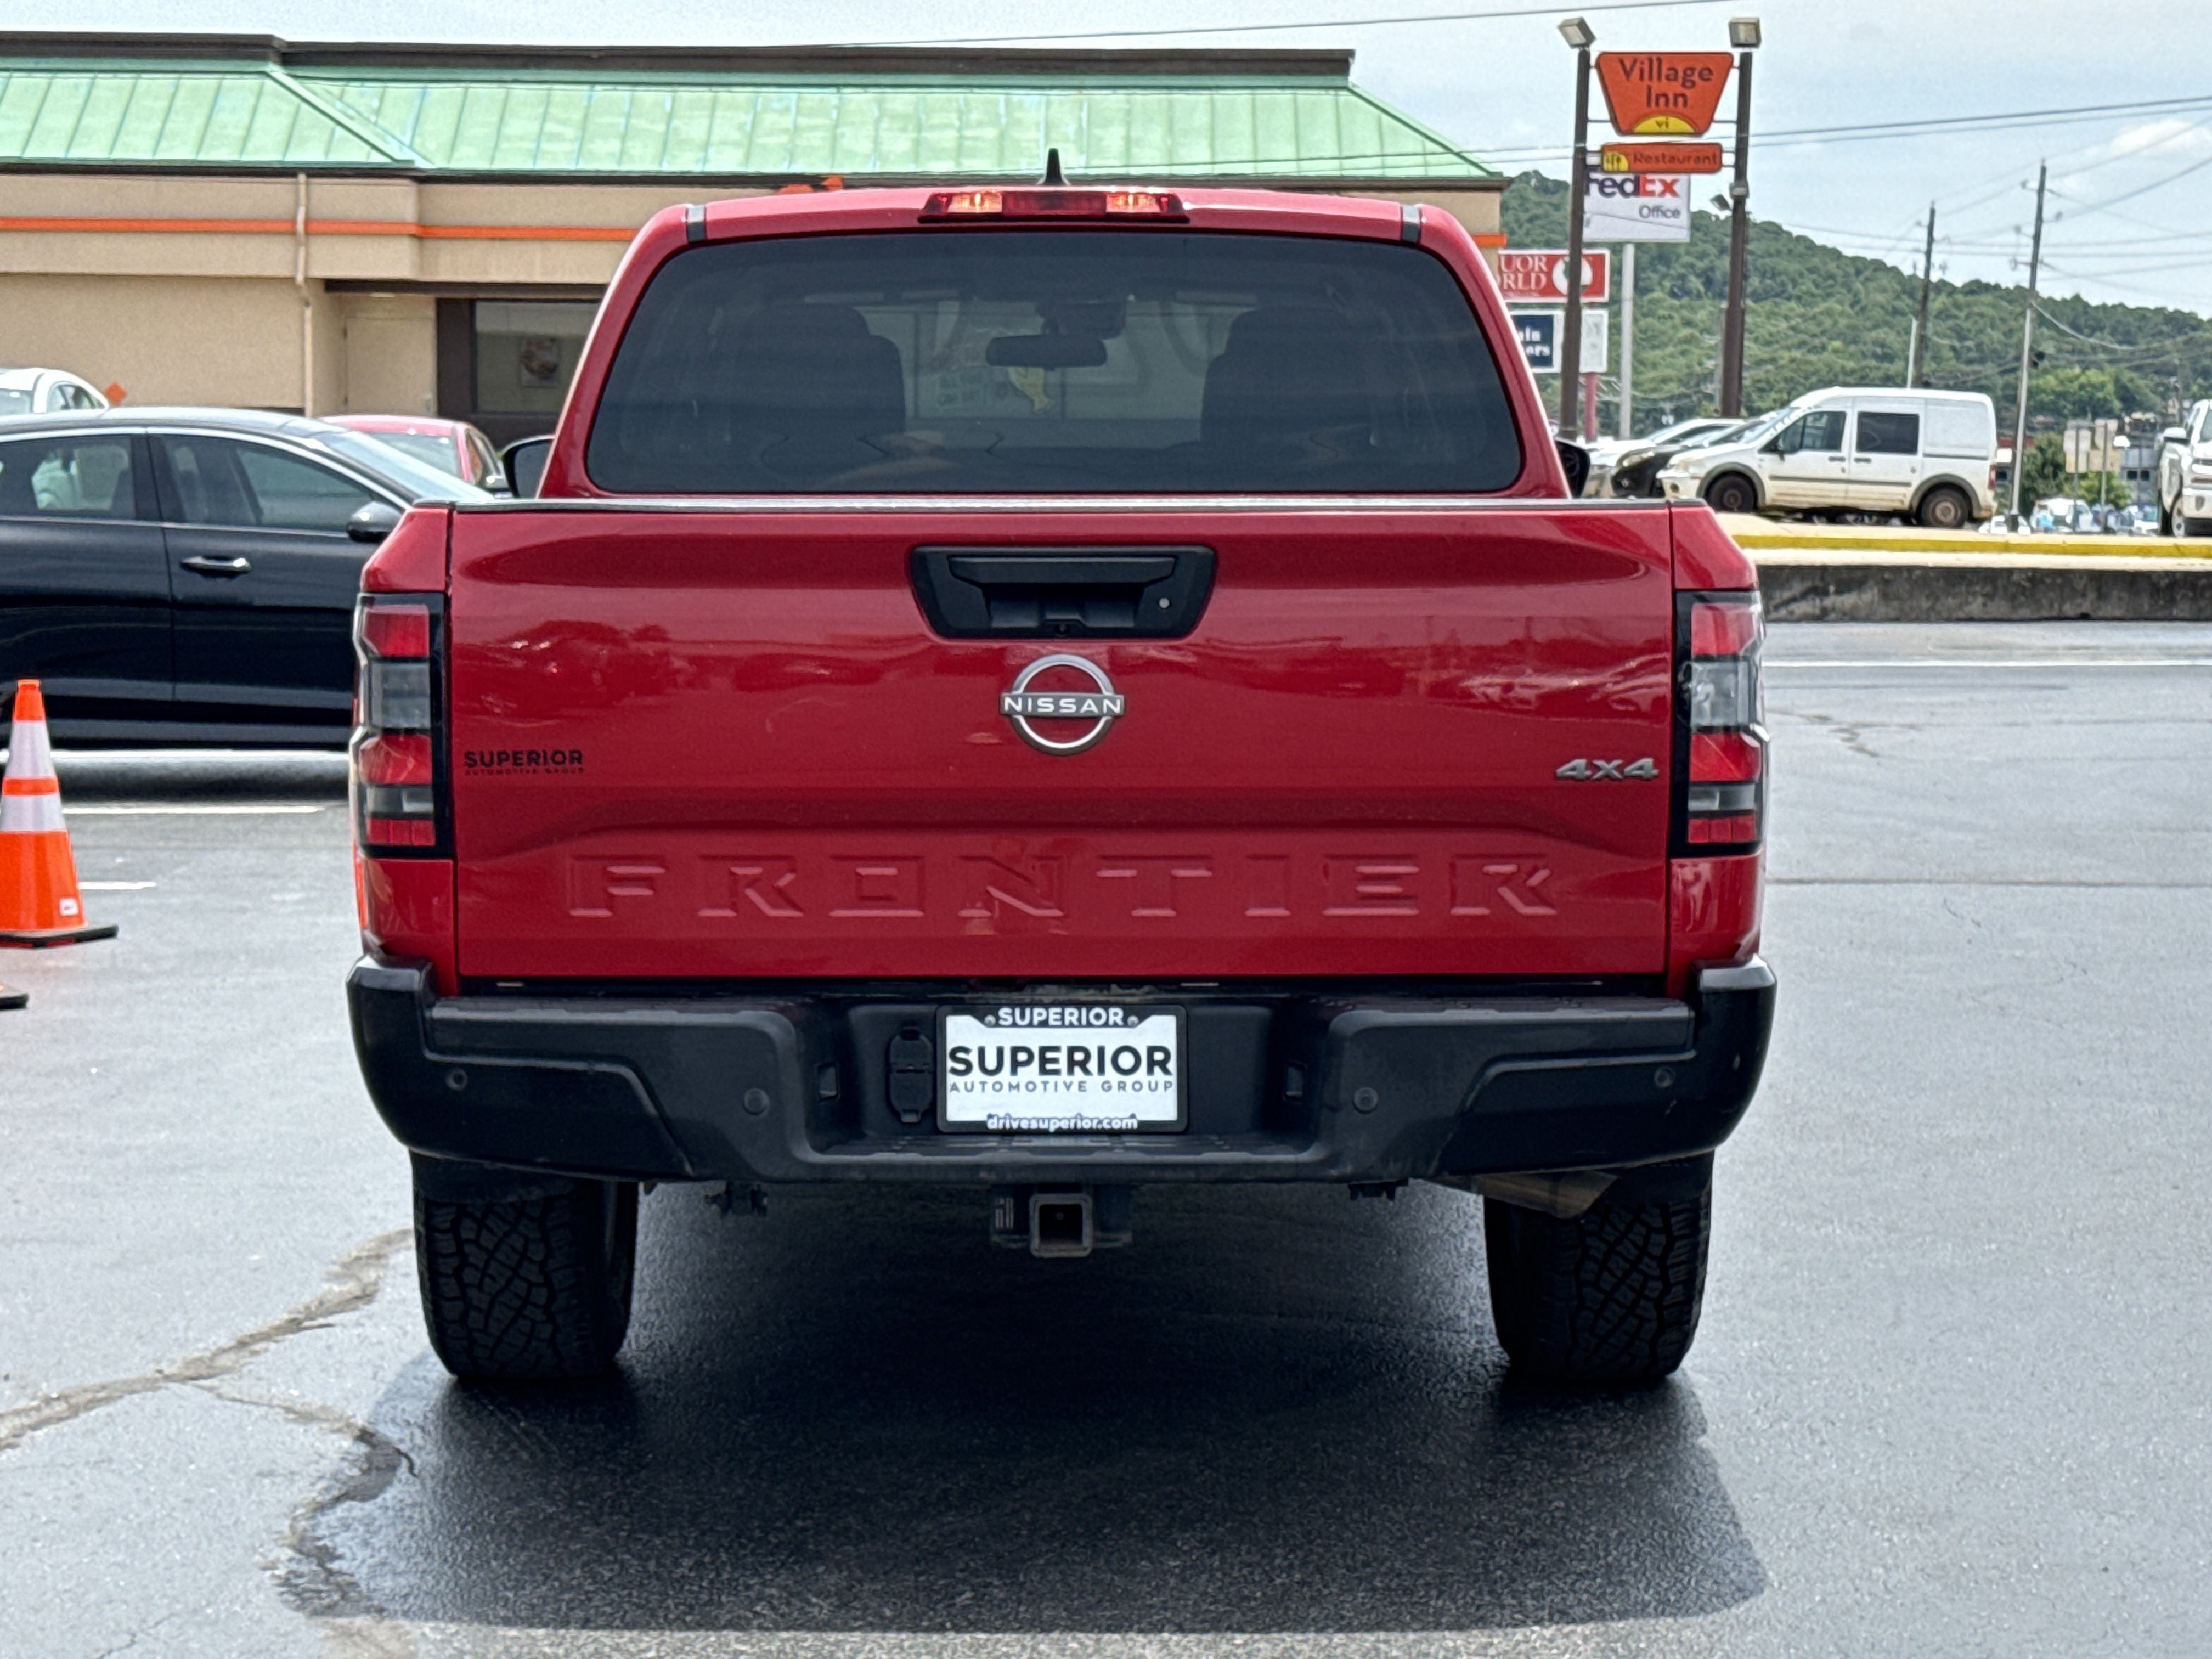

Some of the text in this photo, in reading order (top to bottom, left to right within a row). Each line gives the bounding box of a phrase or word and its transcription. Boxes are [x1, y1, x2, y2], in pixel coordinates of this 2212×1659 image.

[1619, 57, 1714, 89] Village
[1646, 84, 1688, 108] Inn
[1655, 116, 1669, 129] vi
[1633, 151, 1717, 165] Restaurant
[1638, 204, 1682, 219] Office
[1004, 697, 1121, 714] NISSAN
[464, 749, 583, 768] SUPERIOR
[569, 854, 1558, 917] FRONTIER
[997, 1007, 1125, 1026] SUPERIOR
[948, 1045, 1173, 1077] SUPERIOR
[949, 1080, 1173, 1094] AUTOMOTIVE GROUP
[986, 1113, 1138, 1133] drivesuperior.com
